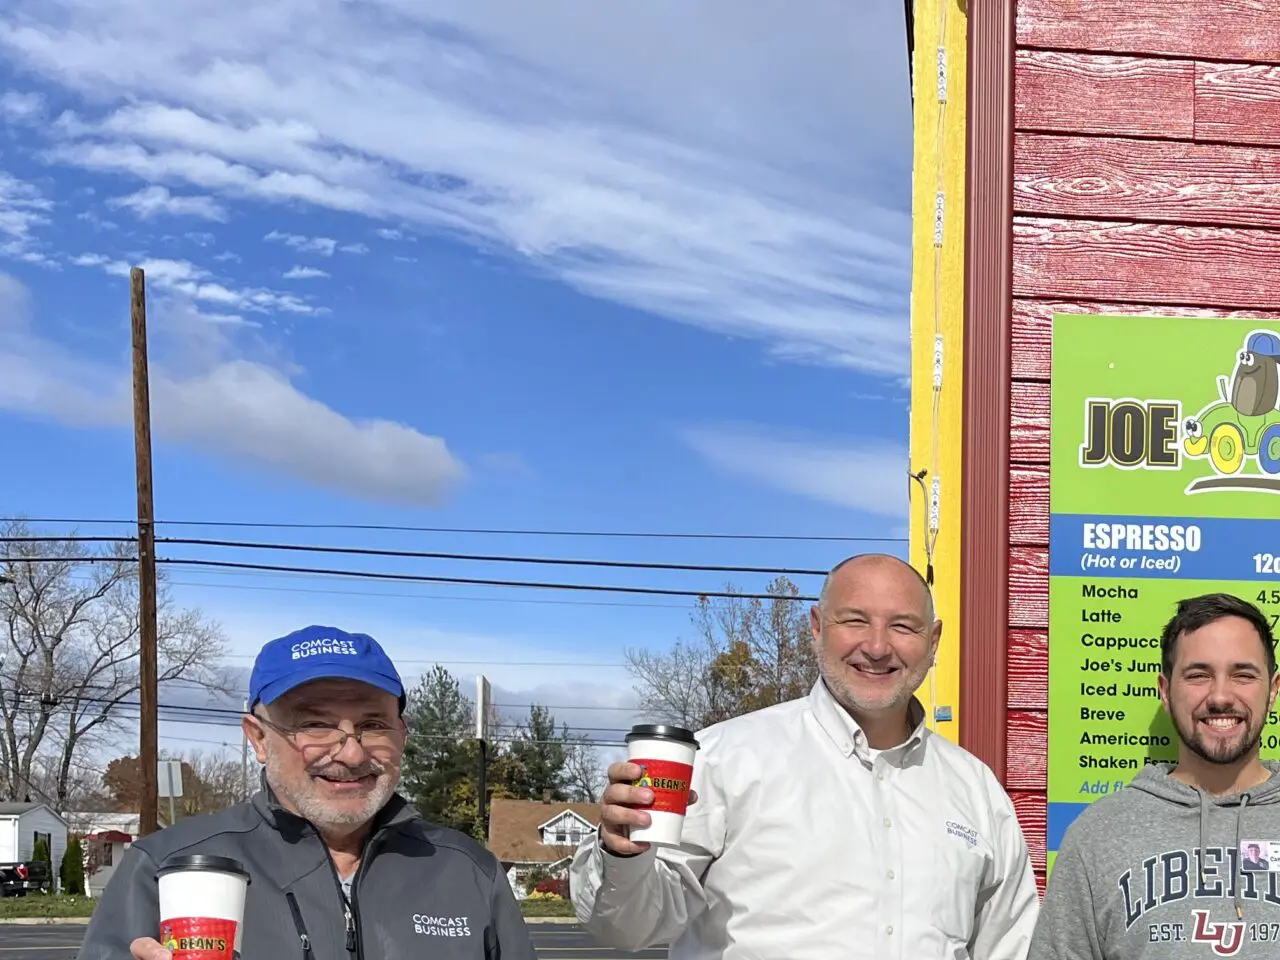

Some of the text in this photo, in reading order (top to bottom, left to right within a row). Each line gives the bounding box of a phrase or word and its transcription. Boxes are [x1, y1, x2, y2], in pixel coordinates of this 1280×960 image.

[1083, 401, 1178, 466] JOE
[1084, 523, 1201, 551] ESPRESSO
[1081, 553, 1116, 570] (Hot
[1120, 558, 1137, 568] or
[1141, 556, 1180, 573] Iced)
[1083, 585, 1138, 598] Mocha
[1082, 610, 1121, 622] Latte
[291, 638, 354, 652] COMCAST
[292, 646, 357, 660] BUSINESS
[1081, 659, 1122, 671] Joe's
[1081, 683, 1117, 696] Iced
[1081, 707, 1125, 720] Breve
[1079, 732, 1171, 747] Americano
[1080, 755, 1137, 768] Shaken
[653, 777, 687, 792] BEAN'S
[1078, 781, 1110, 796] Add
[946, 821, 978, 837] COMCAST
[947, 828, 977, 846] BUSINESS
[412, 914, 469, 926] COMCAST
[414, 924, 472, 938] BUSINESS
[1149, 923, 1187, 942] EST.
[180, 938, 226, 951] BEAN'S
